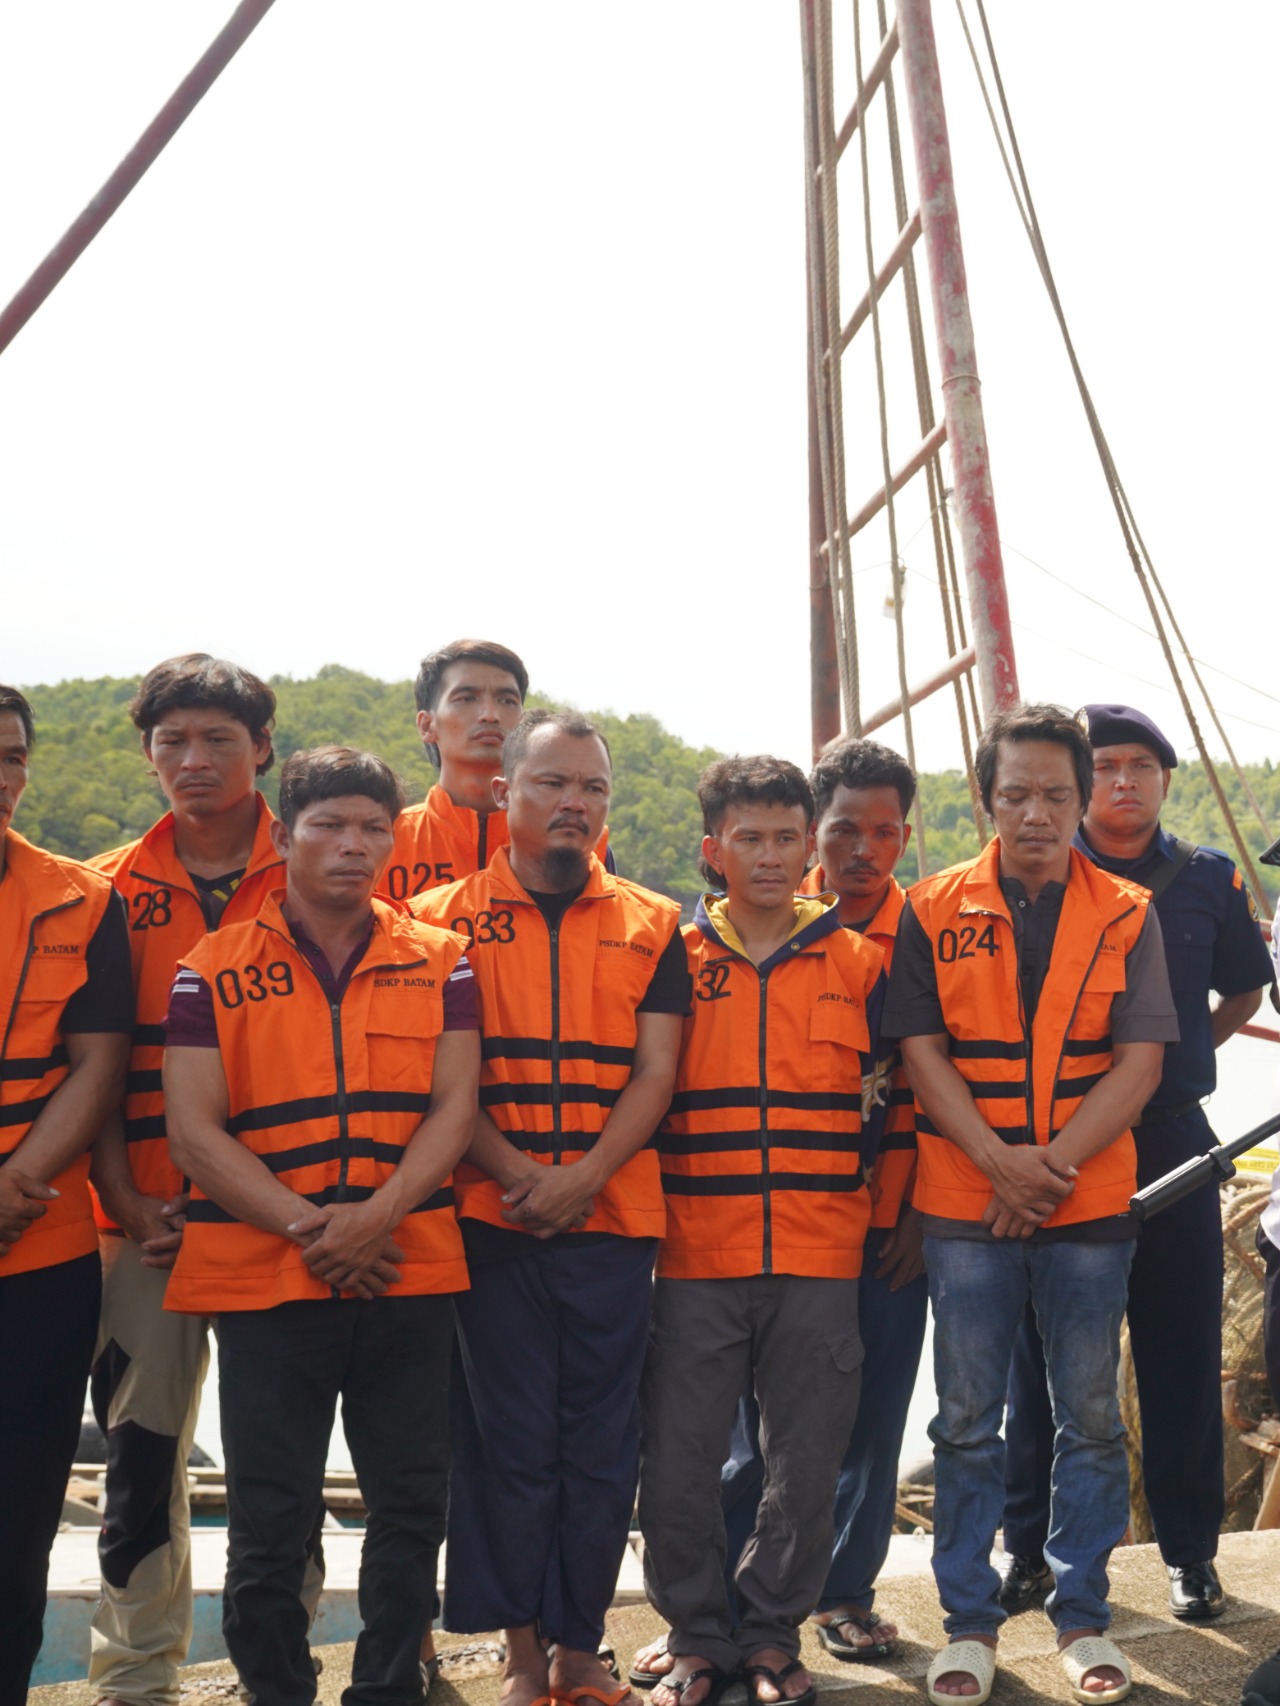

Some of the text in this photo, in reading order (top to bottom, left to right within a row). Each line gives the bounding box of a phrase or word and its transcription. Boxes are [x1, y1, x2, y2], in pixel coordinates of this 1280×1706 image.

[388, 862, 456, 901] 025
[124, 888, 171, 931] 28
[43, 945, 79, 954] BATAM
[451, 910, 516, 951] 033
[629, 941, 655, 958] BATAM
[938, 923, 1000, 964] 024
[215, 961, 295, 1010] 039
[403, 977, 436, 988] BATAM
